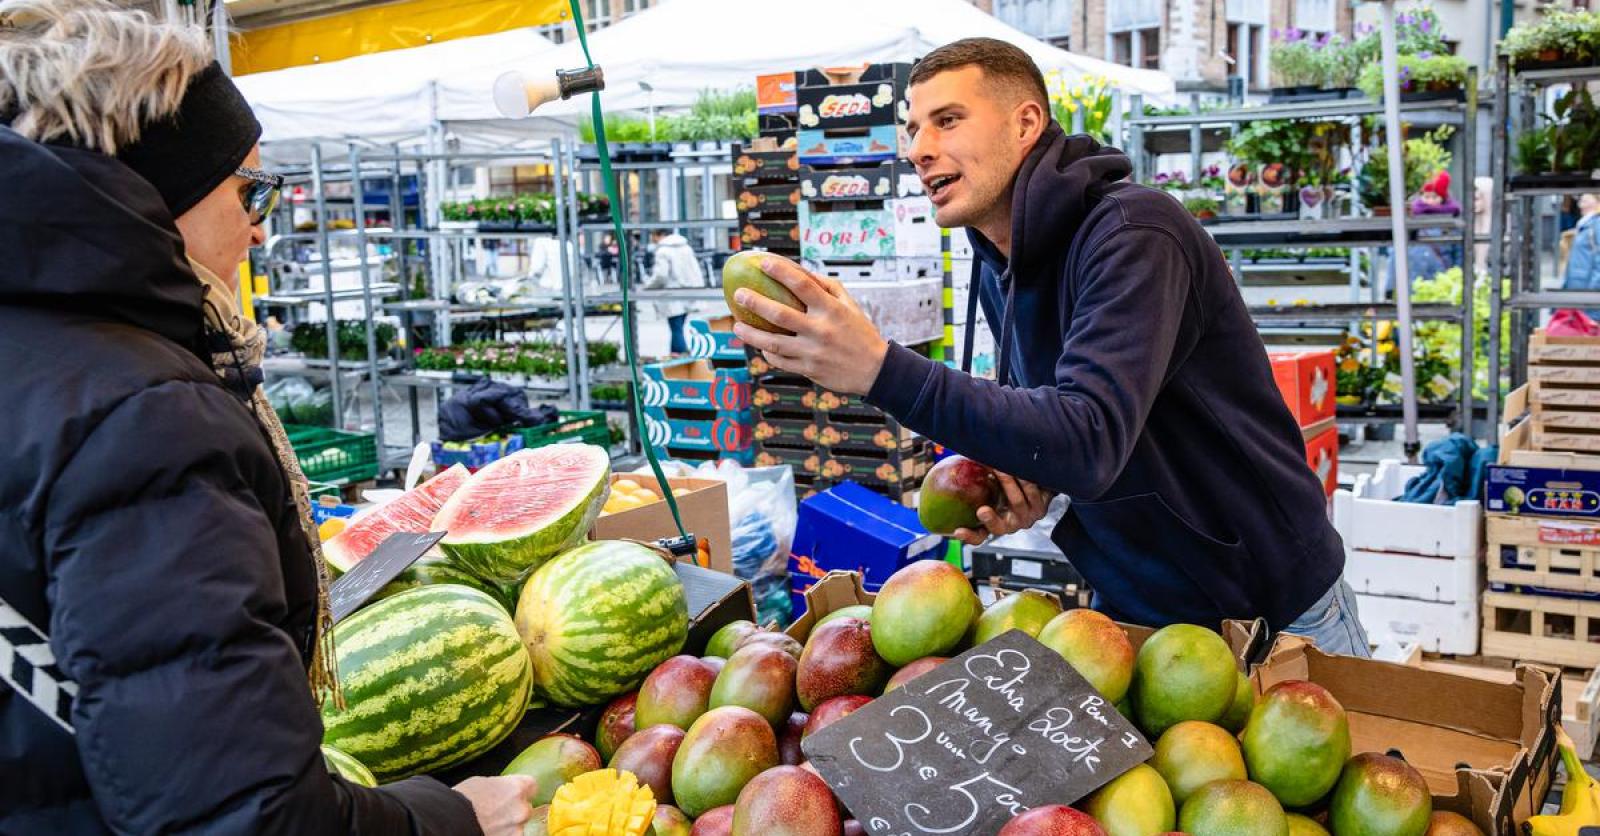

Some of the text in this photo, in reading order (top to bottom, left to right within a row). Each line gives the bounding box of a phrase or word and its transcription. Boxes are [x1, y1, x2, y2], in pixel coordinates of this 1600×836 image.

[820, 98, 871, 118] SEDA
[823, 180, 869, 197] SEDA
[849, 705, 933, 772] 3
[924, 678, 1027, 764] Mango
